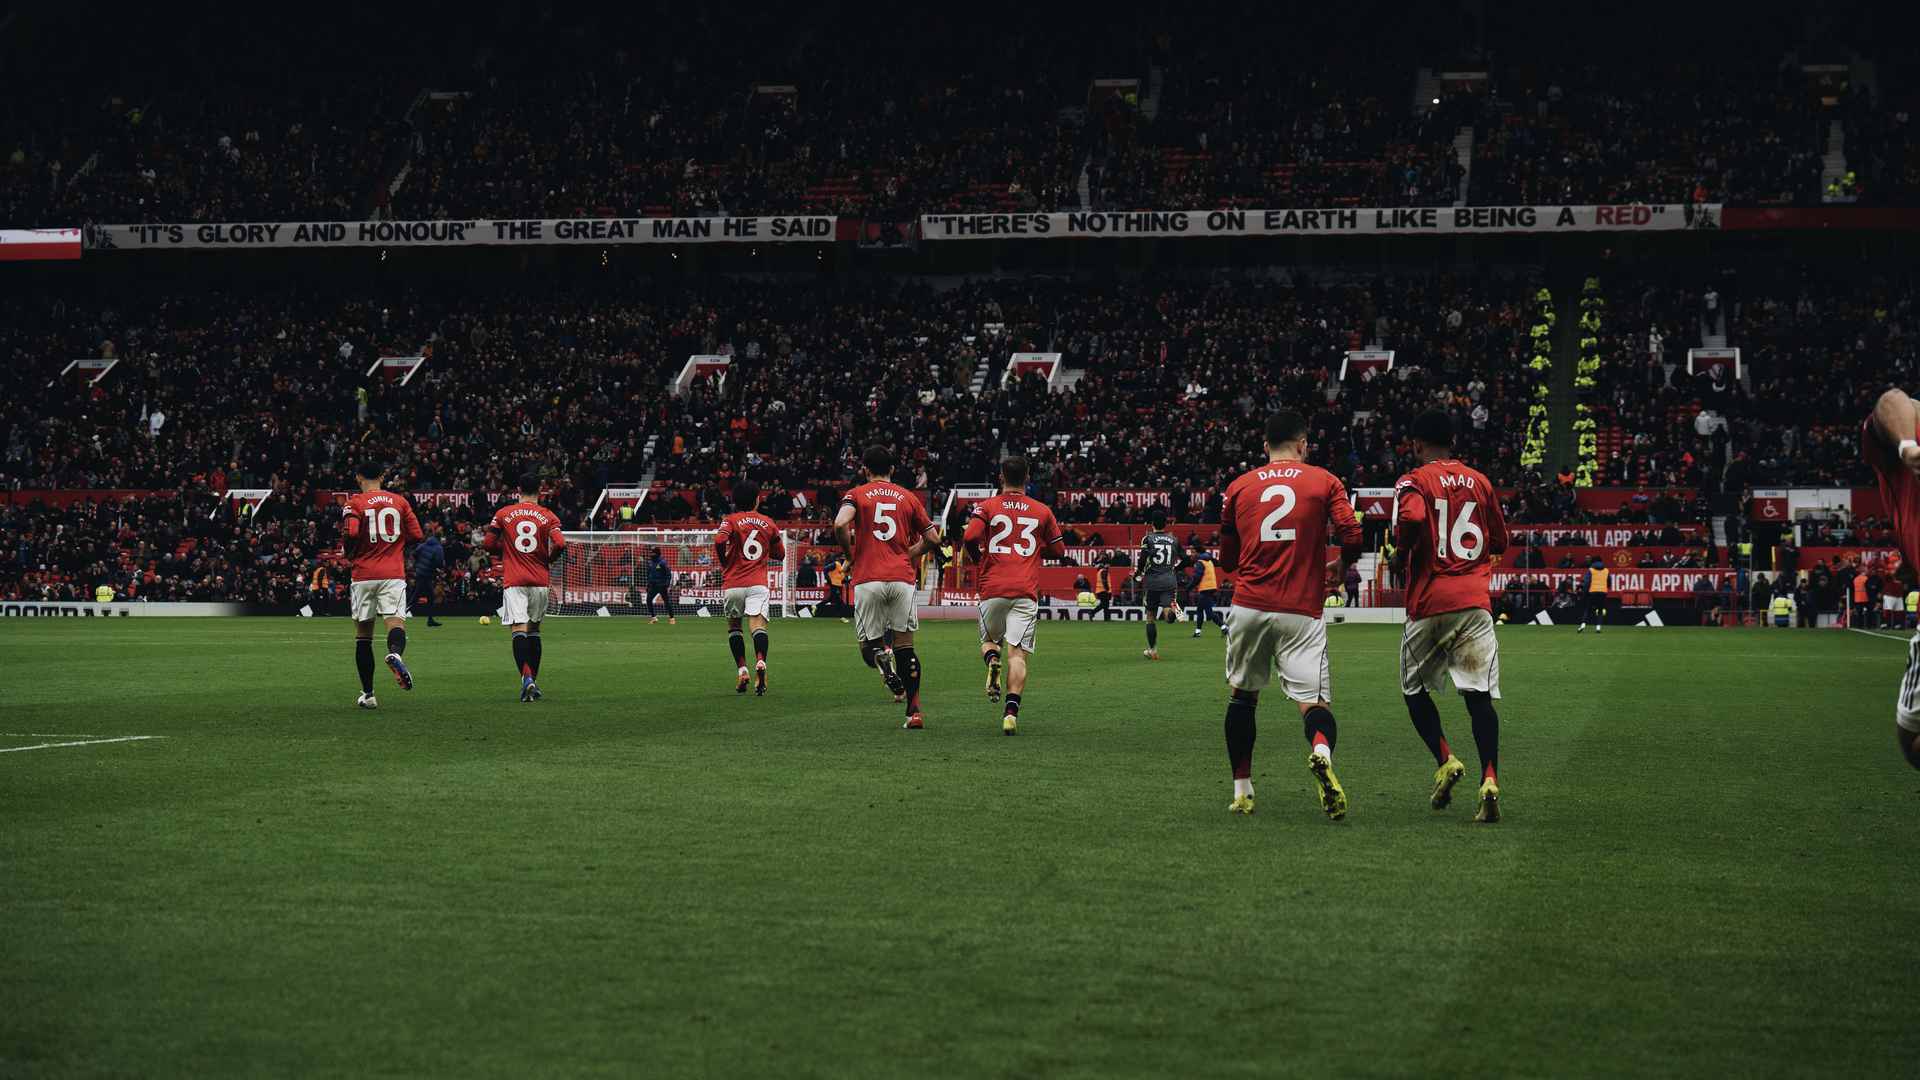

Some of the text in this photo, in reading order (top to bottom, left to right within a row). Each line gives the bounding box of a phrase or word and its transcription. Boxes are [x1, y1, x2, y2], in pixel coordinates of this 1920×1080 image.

[129, 217, 831, 244] "IT'S GLORY AND HONOUR" THE GREAT MAN HE SAID
[927, 206, 1665, 235] "THERE'S NOTHING ON EARTH LIKE BEING A RED"
[1257, 468, 1303, 481] DALOT
[1439, 475, 1475, 489] AMAD
[368, 496, 393, 505] CUNHA
[865, 488, 905, 502] MAGUIRE
[1070, 491, 1133, 508] DONLOD
[1002, 501, 1029, 512] SHAW
[1260, 484, 1297, 542] 2
[364, 507, 401, 544] 10
[872, 502, 897, 542] 5
[1434, 498, 1484, 560] 16
[514, 520, 538, 553] 8
[743, 529, 763, 560] 6
[988, 514, 1039, 557] 23
[1604, 530, 1632, 547] APP
[1152, 544, 1172, 565] 31
[1651, 573, 1680, 592] APP
[944, 592, 971, 600] NIALL
